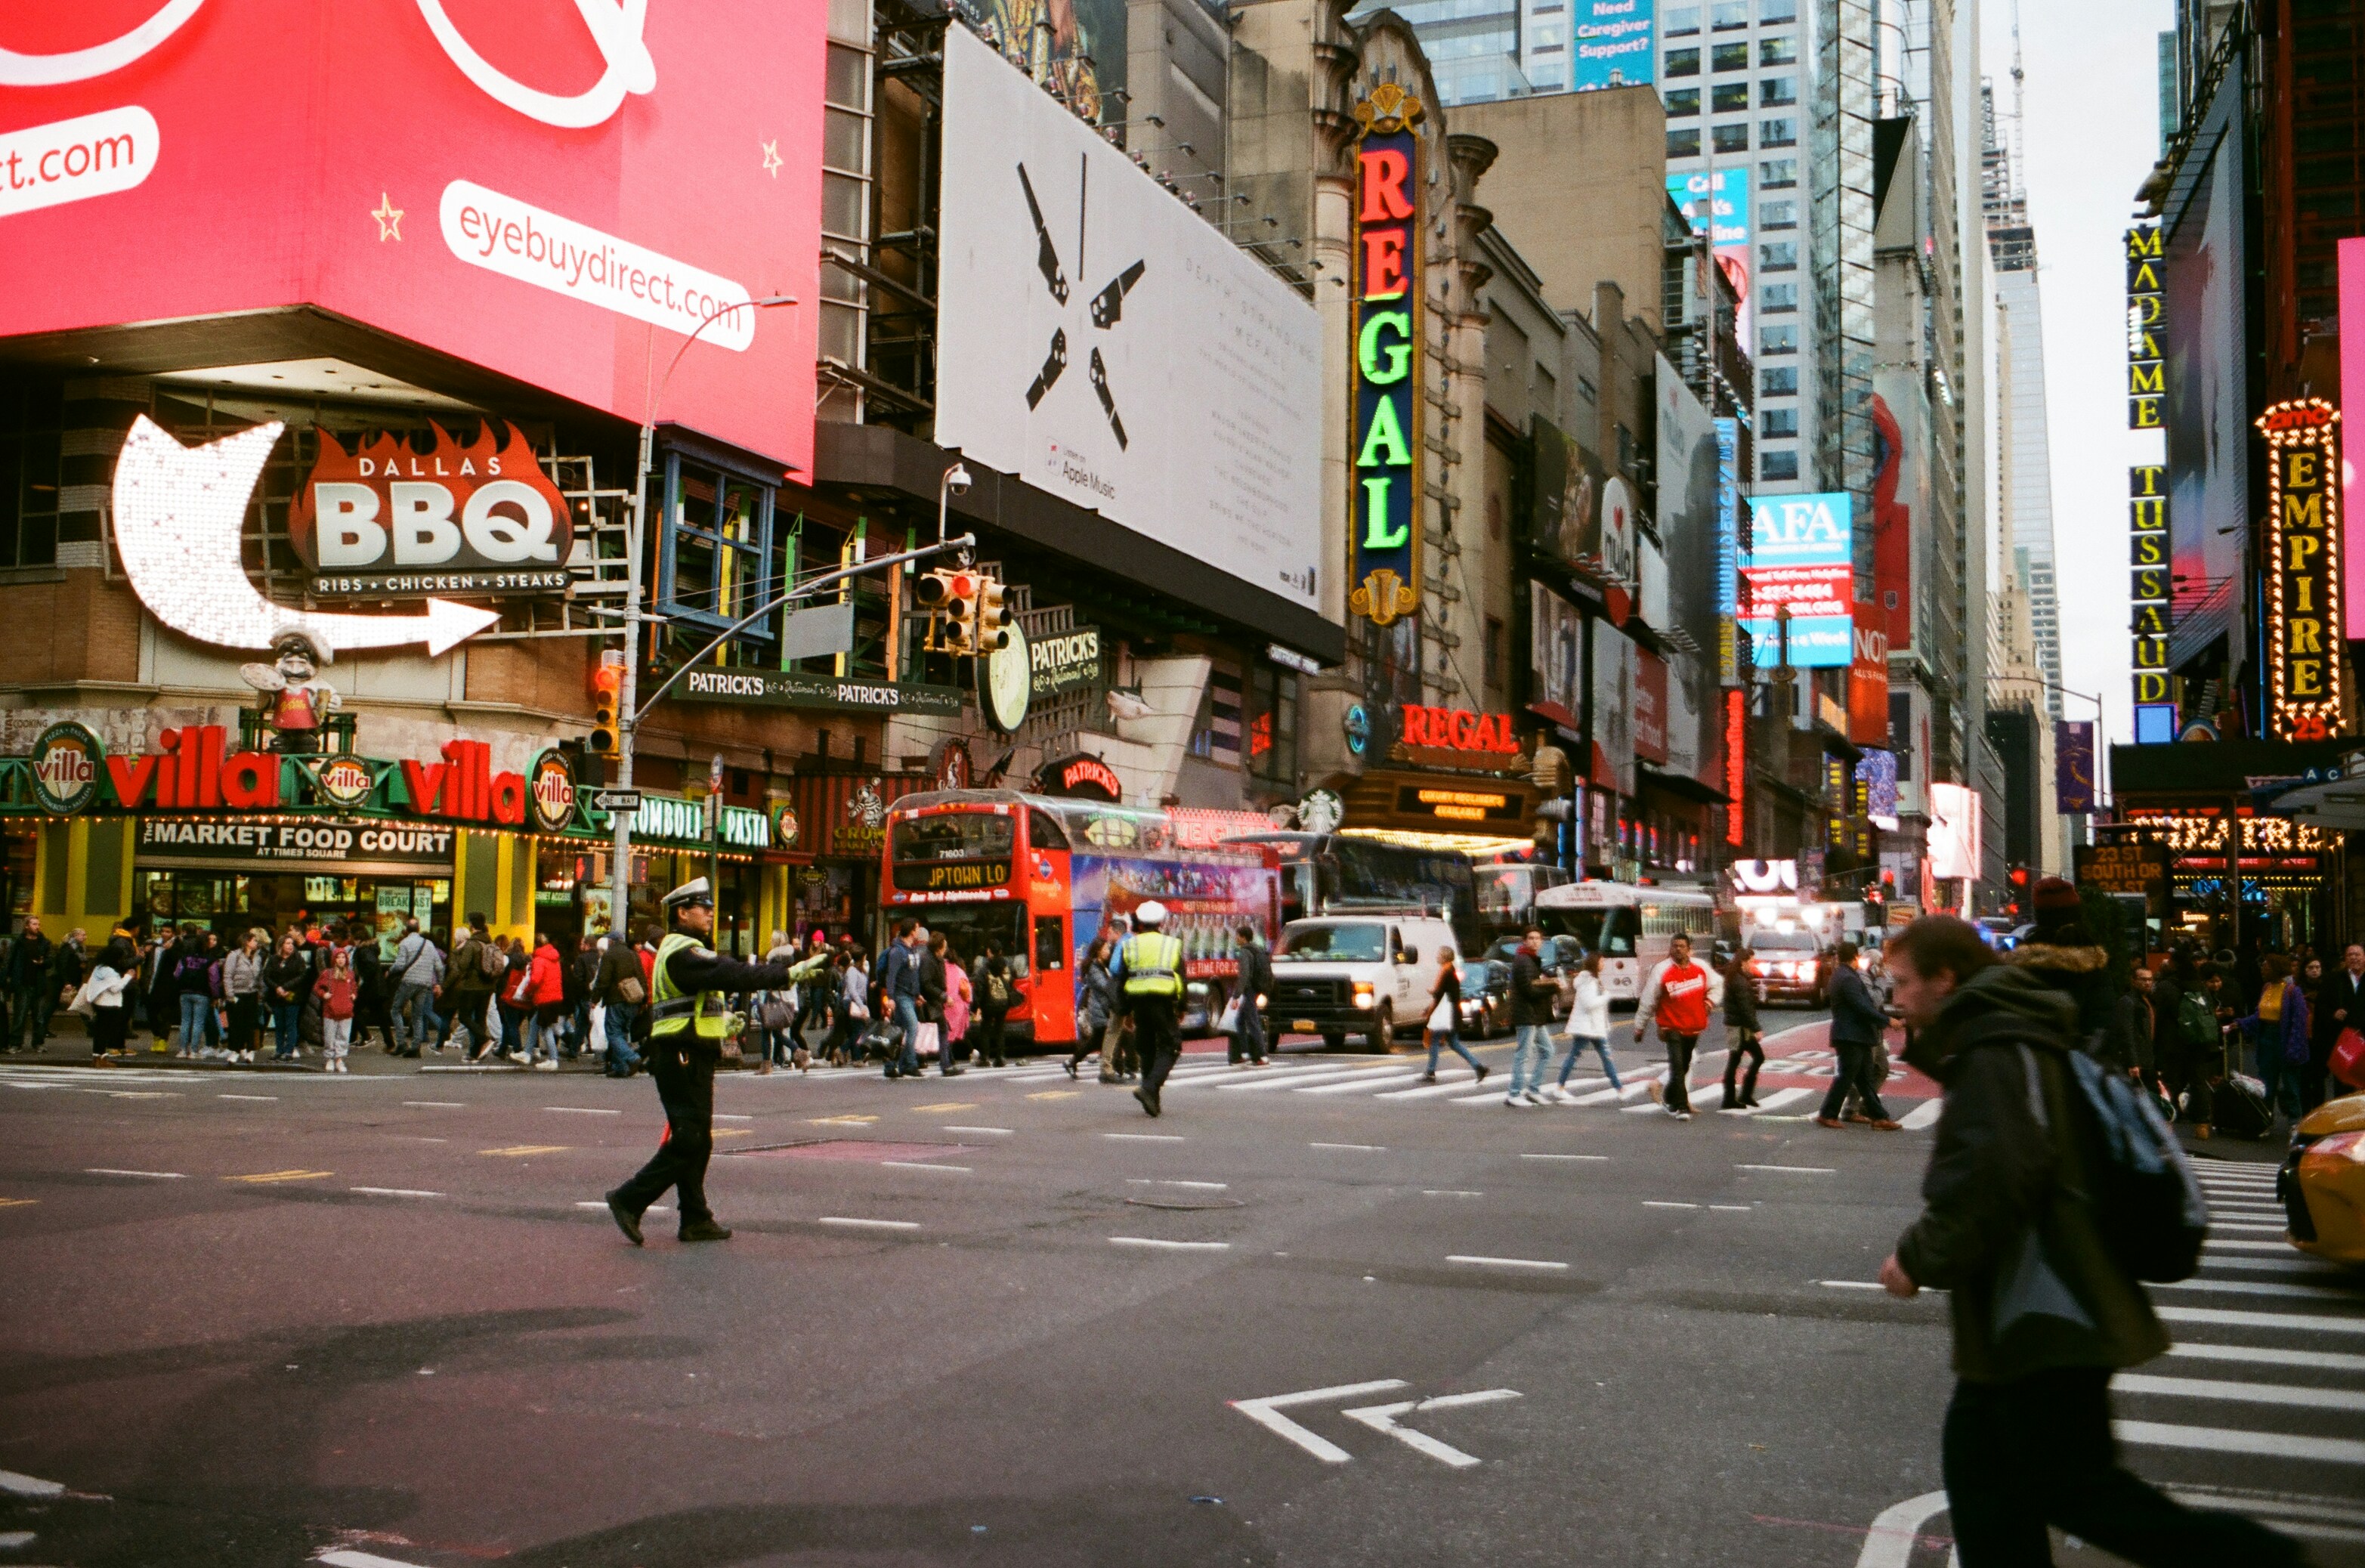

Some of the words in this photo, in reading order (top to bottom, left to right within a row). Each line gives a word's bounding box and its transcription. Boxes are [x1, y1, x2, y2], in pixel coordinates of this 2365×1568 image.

[1593, 1, 1635, 15] Need
[1577, 19, 1650, 37] Caregiver
[1578, 37, 1649, 58] Support?
[0, 131, 134, 191] t.com
[1686, 173, 1725, 193] Call
[459, 205, 742, 333] eyebuydirect.com
[2128, 227, 2165, 428] MADAME
[1357, 150, 1414, 549] REGAL
[2267, 407, 2329, 431] amc
[359, 456, 502, 478] DALLAS
[1062, 460, 1088, 487] Apple
[1090, 471, 1115, 499] Music
[314, 480, 558, 567] BBQ
[318, 578, 363, 592] RIBS
[385, 575, 474, 591] CHICKEN
[496, 573, 565, 589] STEAKS
[2135, 465, 2167, 702] TUSSAUD
[2281, 453, 2326, 696] EMPIRE
[1031, 632, 1099, 672] PATRICK'S
[689, 671, 765, 696] PATRICK'S
[837, 683, 899, 706] PATRICK'S
[1402, 704, 1520, 754] REGAL
[2292, 717, 2326, 740] 25
[33, 752, 94, 784] villa
[105, 725, 282, 809] villa
[320, 768, 371, 790] villa
[1063, 759, 1119, 797] PATRICK'S
[2307, 769, 2317, 780] A
[2328, 769, 2339, 781] C
[400, 740, 524, 824] villa
[533, 775, 574, 806] villa
[599, 796, 614, 805] ONE
[621, 796, 636, 805] WAY
[604, 798, 700, 840] SROMBOLI
[726, 811, 768, 847] PASTA
[833, 827, 886, 840] CRUM
[144, 822, 153, 844] The
[155, 822, 271, 846] MARKET
[279, 826, 352, 849] FOOD
[360, 830, 450, 853] COURT
[256, 847, 271, 856] AT
[273, 848, 303, 857] TIMES
[305, 849, 347, 859] SQUARE
[939, 849, 965, 858] 71603
[2121, 846, 2143, 861] ST
[2080, 863, 2136, 880] SOUTH
[2138, 862, 2163, 878] OR
[909, 893, 926, 903] New
[927, 892, 944, 902] York
[944, 889, 992, 902] Sightseeing
[2191, 880, 2256, 895] IMX
[379, 895, 431, 908] BREAKAST
